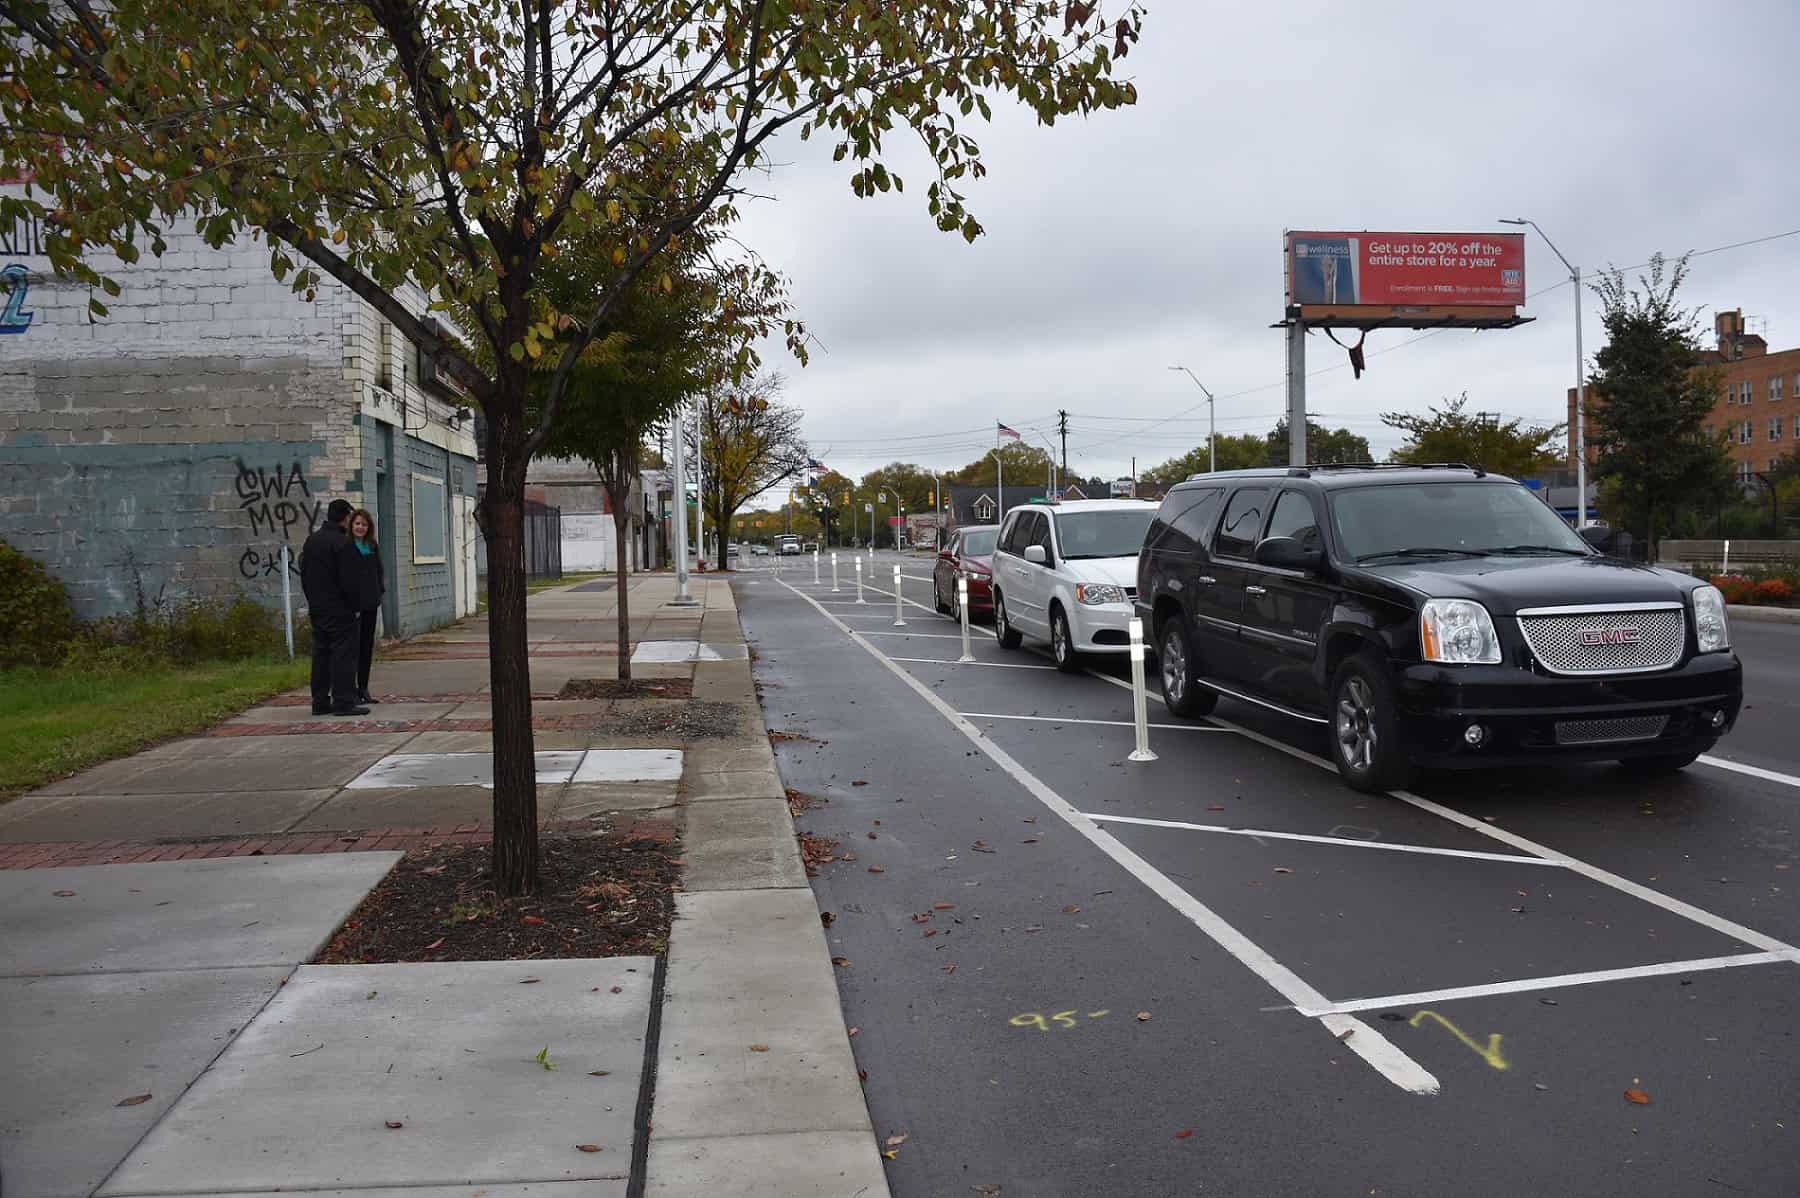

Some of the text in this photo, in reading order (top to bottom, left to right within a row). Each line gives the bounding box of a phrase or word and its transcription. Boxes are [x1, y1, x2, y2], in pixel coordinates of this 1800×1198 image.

[1309, 245, 1350, 256] wellness
[1369, 242, 1502, 255] Get up to 20% off the
[1369, 254, 1496, 269] entire store for a year.
[1581, 628, 1639, 646] GMC
